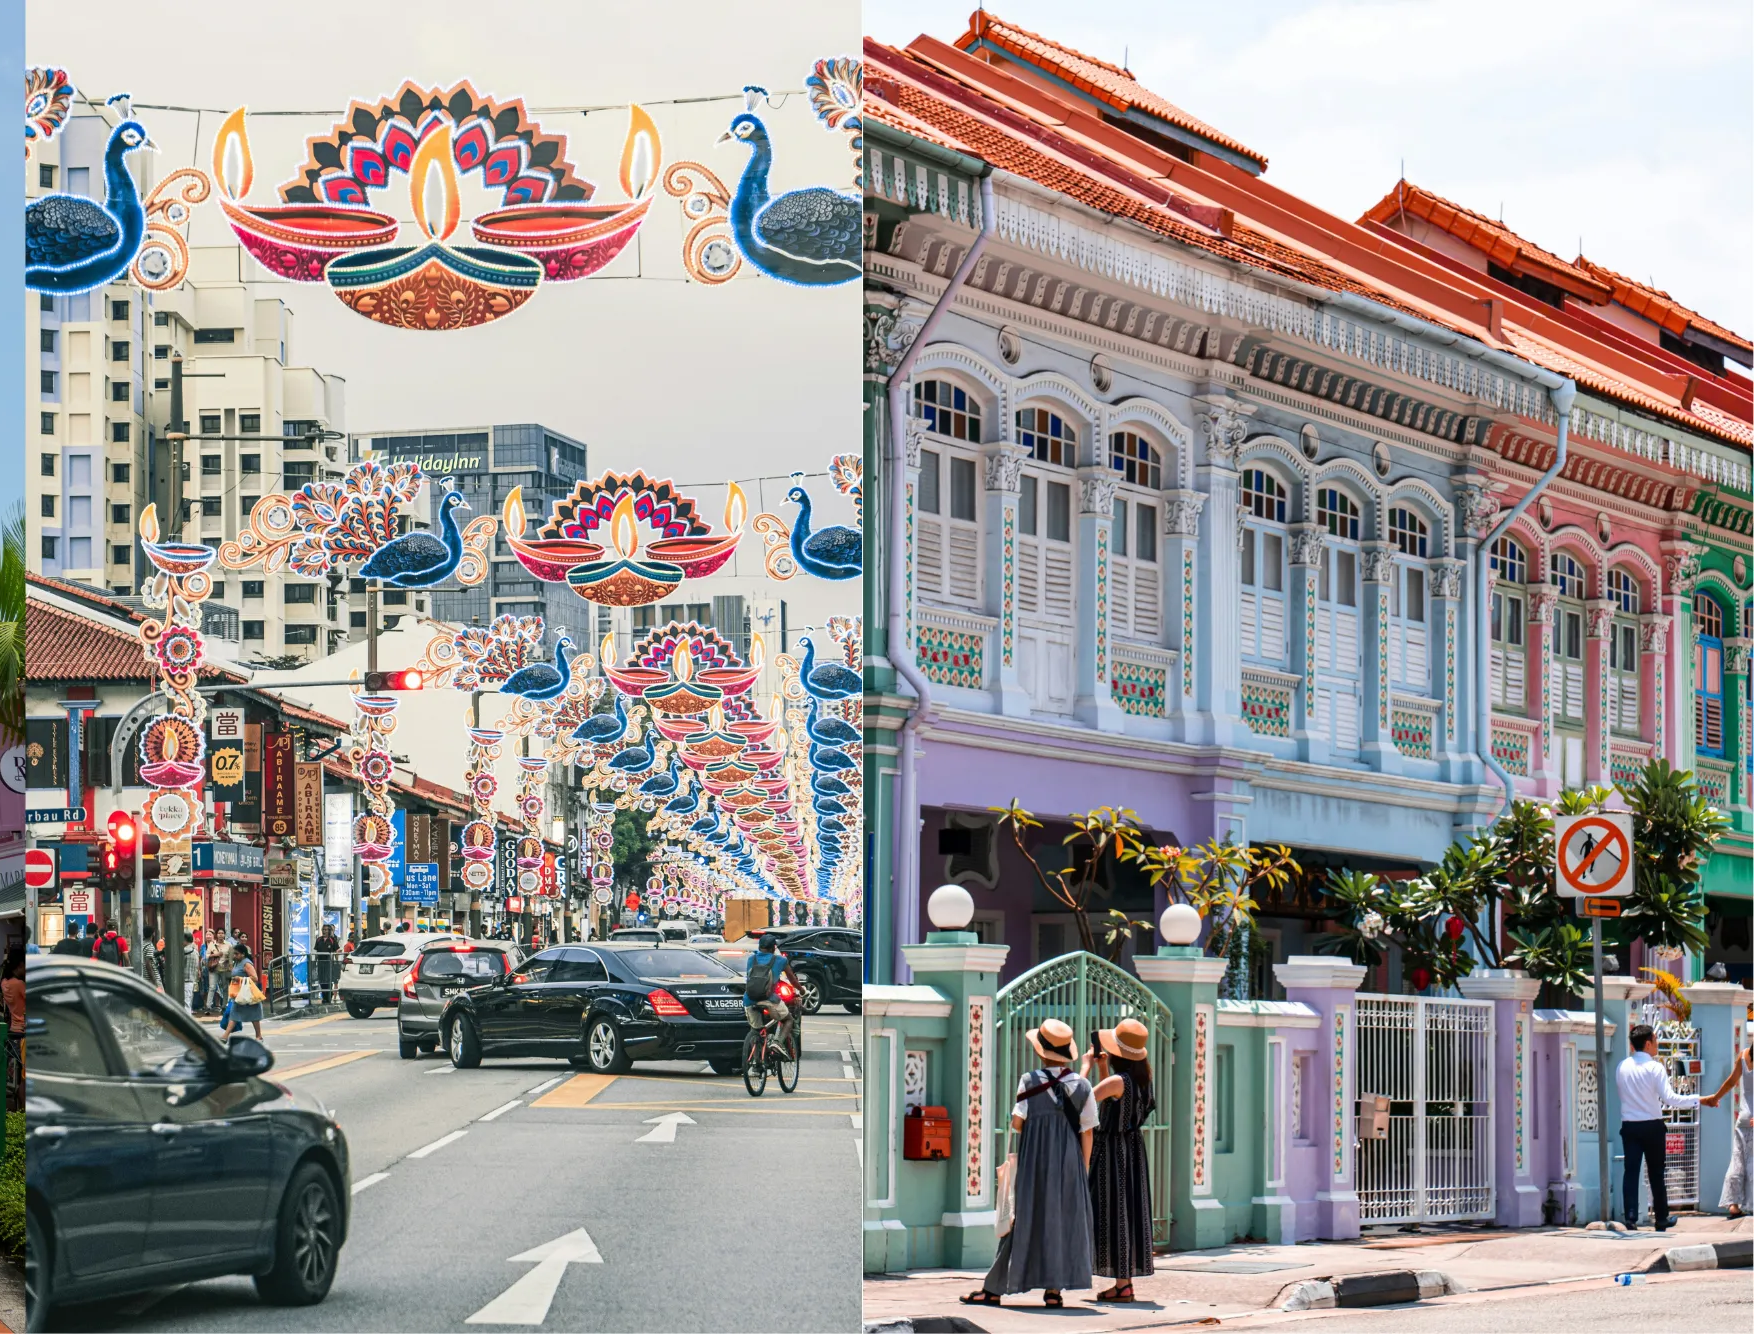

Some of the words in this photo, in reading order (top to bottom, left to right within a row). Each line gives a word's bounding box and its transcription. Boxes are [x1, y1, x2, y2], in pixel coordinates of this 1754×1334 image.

[216, 711, 239, 735] 當
[215, 754, 241, 771] 0.7%
[276, 750, 284, 815] ABIRAAME
[28, 810, 58, 822] rbau
[64, 809, 80, 820] Rd
[159, 804, 183, 812] tekka
[304, 782, 315, 843] ABIRAAME
[274, 822, 285, 834] 85
[412, 815, 421, 861] MONEYMAX
[417, 873, 437, 882] Lane
[505, 840, 517, 897] GOODAY
[69, 890, 90, 912] 當
[183, 900, 201, 919] .7%
[704, 999, 744, 1008] SLX6258R
